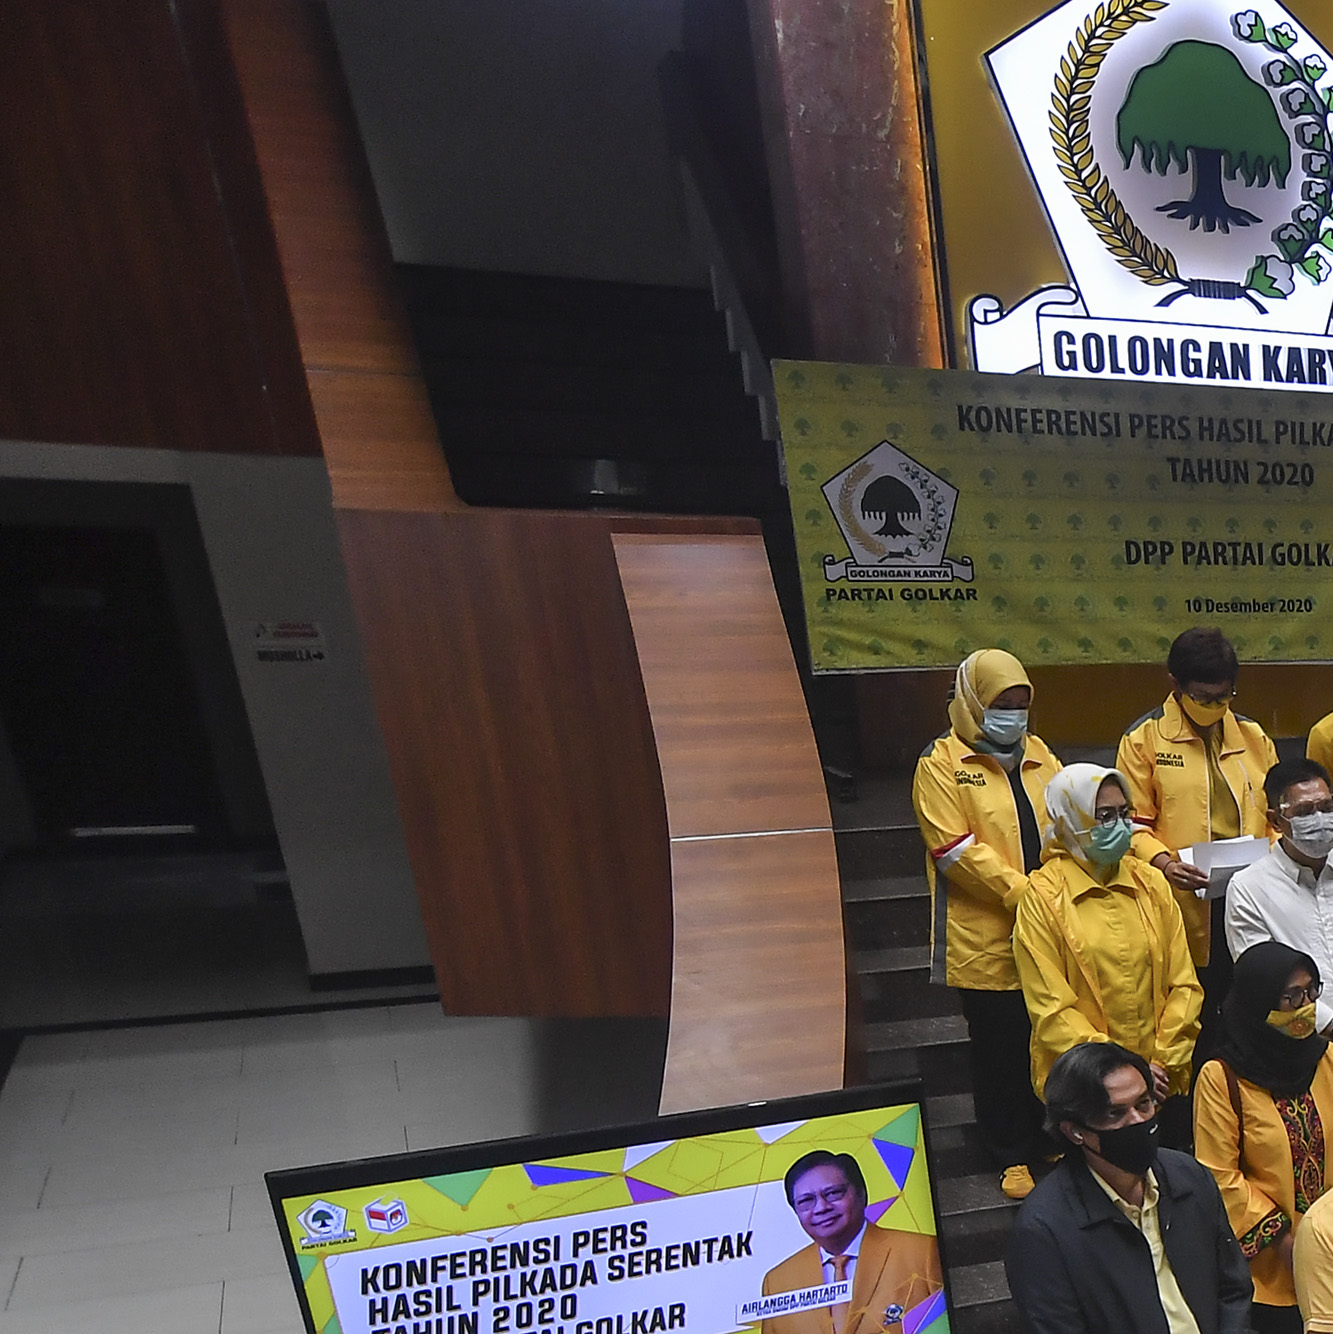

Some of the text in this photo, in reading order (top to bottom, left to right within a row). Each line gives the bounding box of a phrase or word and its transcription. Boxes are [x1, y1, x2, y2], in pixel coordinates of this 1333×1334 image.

[1054, 330, 1251, 381] GOLONGAN
[958, 403, 1121, 439] KONFERENSI
[1130, 413, 1191, 441] PERS
[1200, 417, 1268, 445] HASIL
[1167, 457, 1314, 487] TAHUN 2020
[1125, 540, 1173, 566] DPP
[1182, 541, 1264, 567] PARTAI
[850, 569, 950, 579] GOLONGAN KARYA
[825, 587, 978, 601] PARTAI GOLKAR
[1185, 598, 1313, 613] 10 Desember 2020
[360, 1219, 650, 1295] KONFERENSI PERS
[368, 1230, 756, 1326] HASIL PILKADA SERENTAK
[491, 1293, 579, 1333] 2020
[741, 1283, 848, 1315] AIRLANGGA HARTARTO
